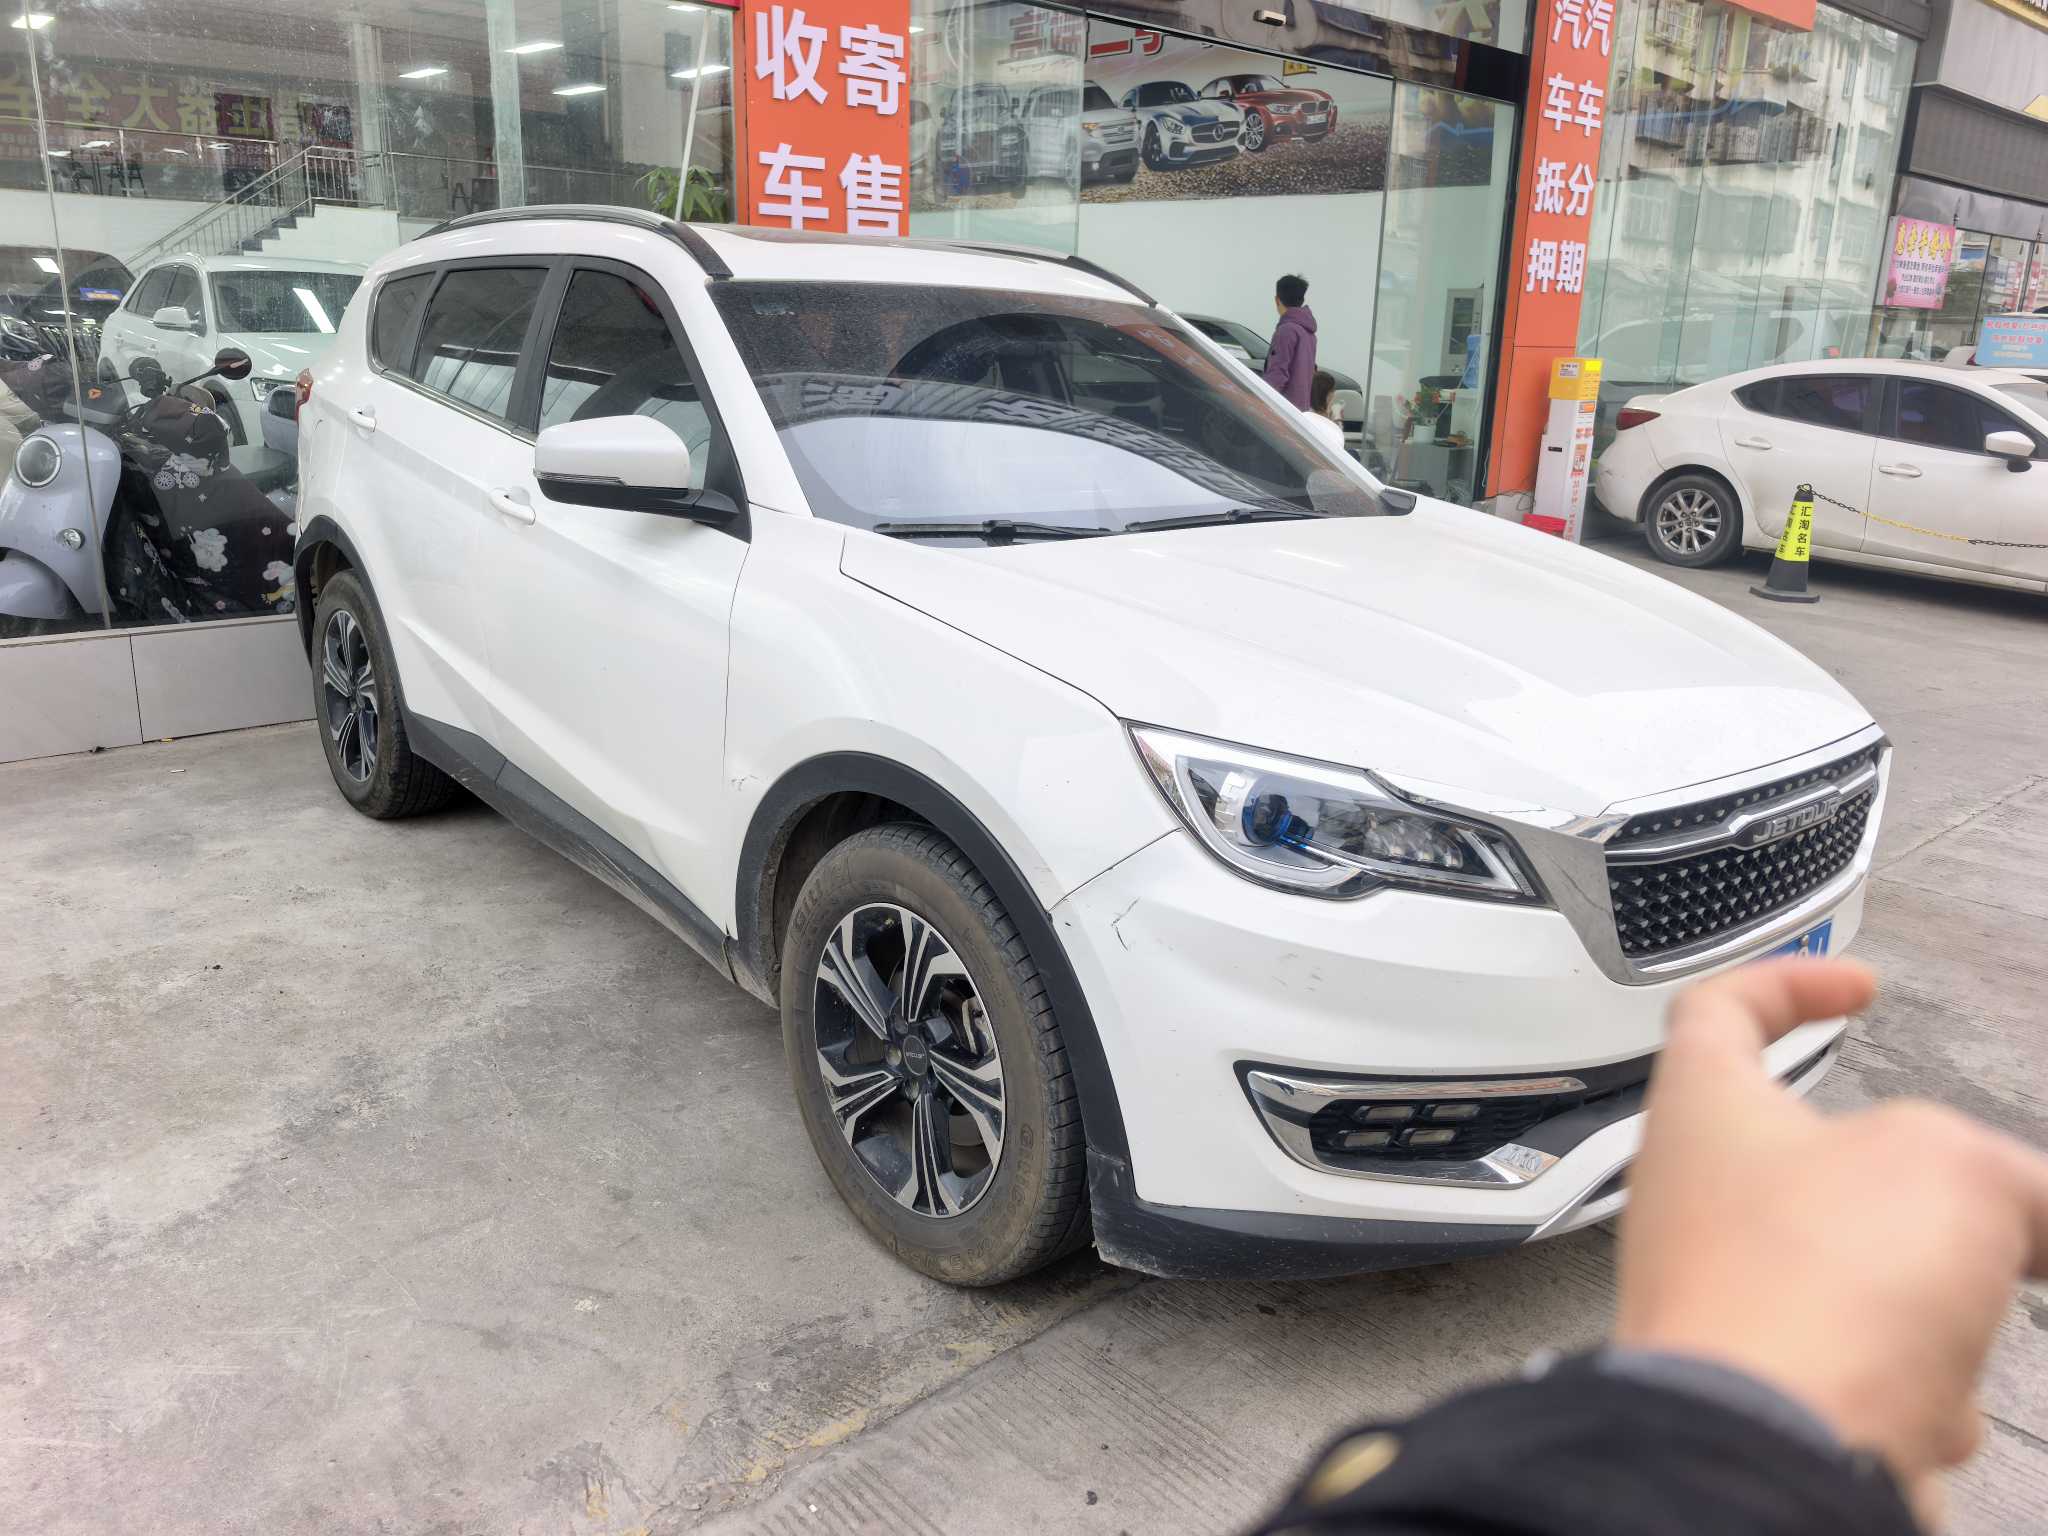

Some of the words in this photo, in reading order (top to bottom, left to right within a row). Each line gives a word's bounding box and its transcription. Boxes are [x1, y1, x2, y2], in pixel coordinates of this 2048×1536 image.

[755, 4, 829, 231] 收车
[838, 23, 907, 237] 寄售
[1753, 796, 1842, 843] JETOUR
